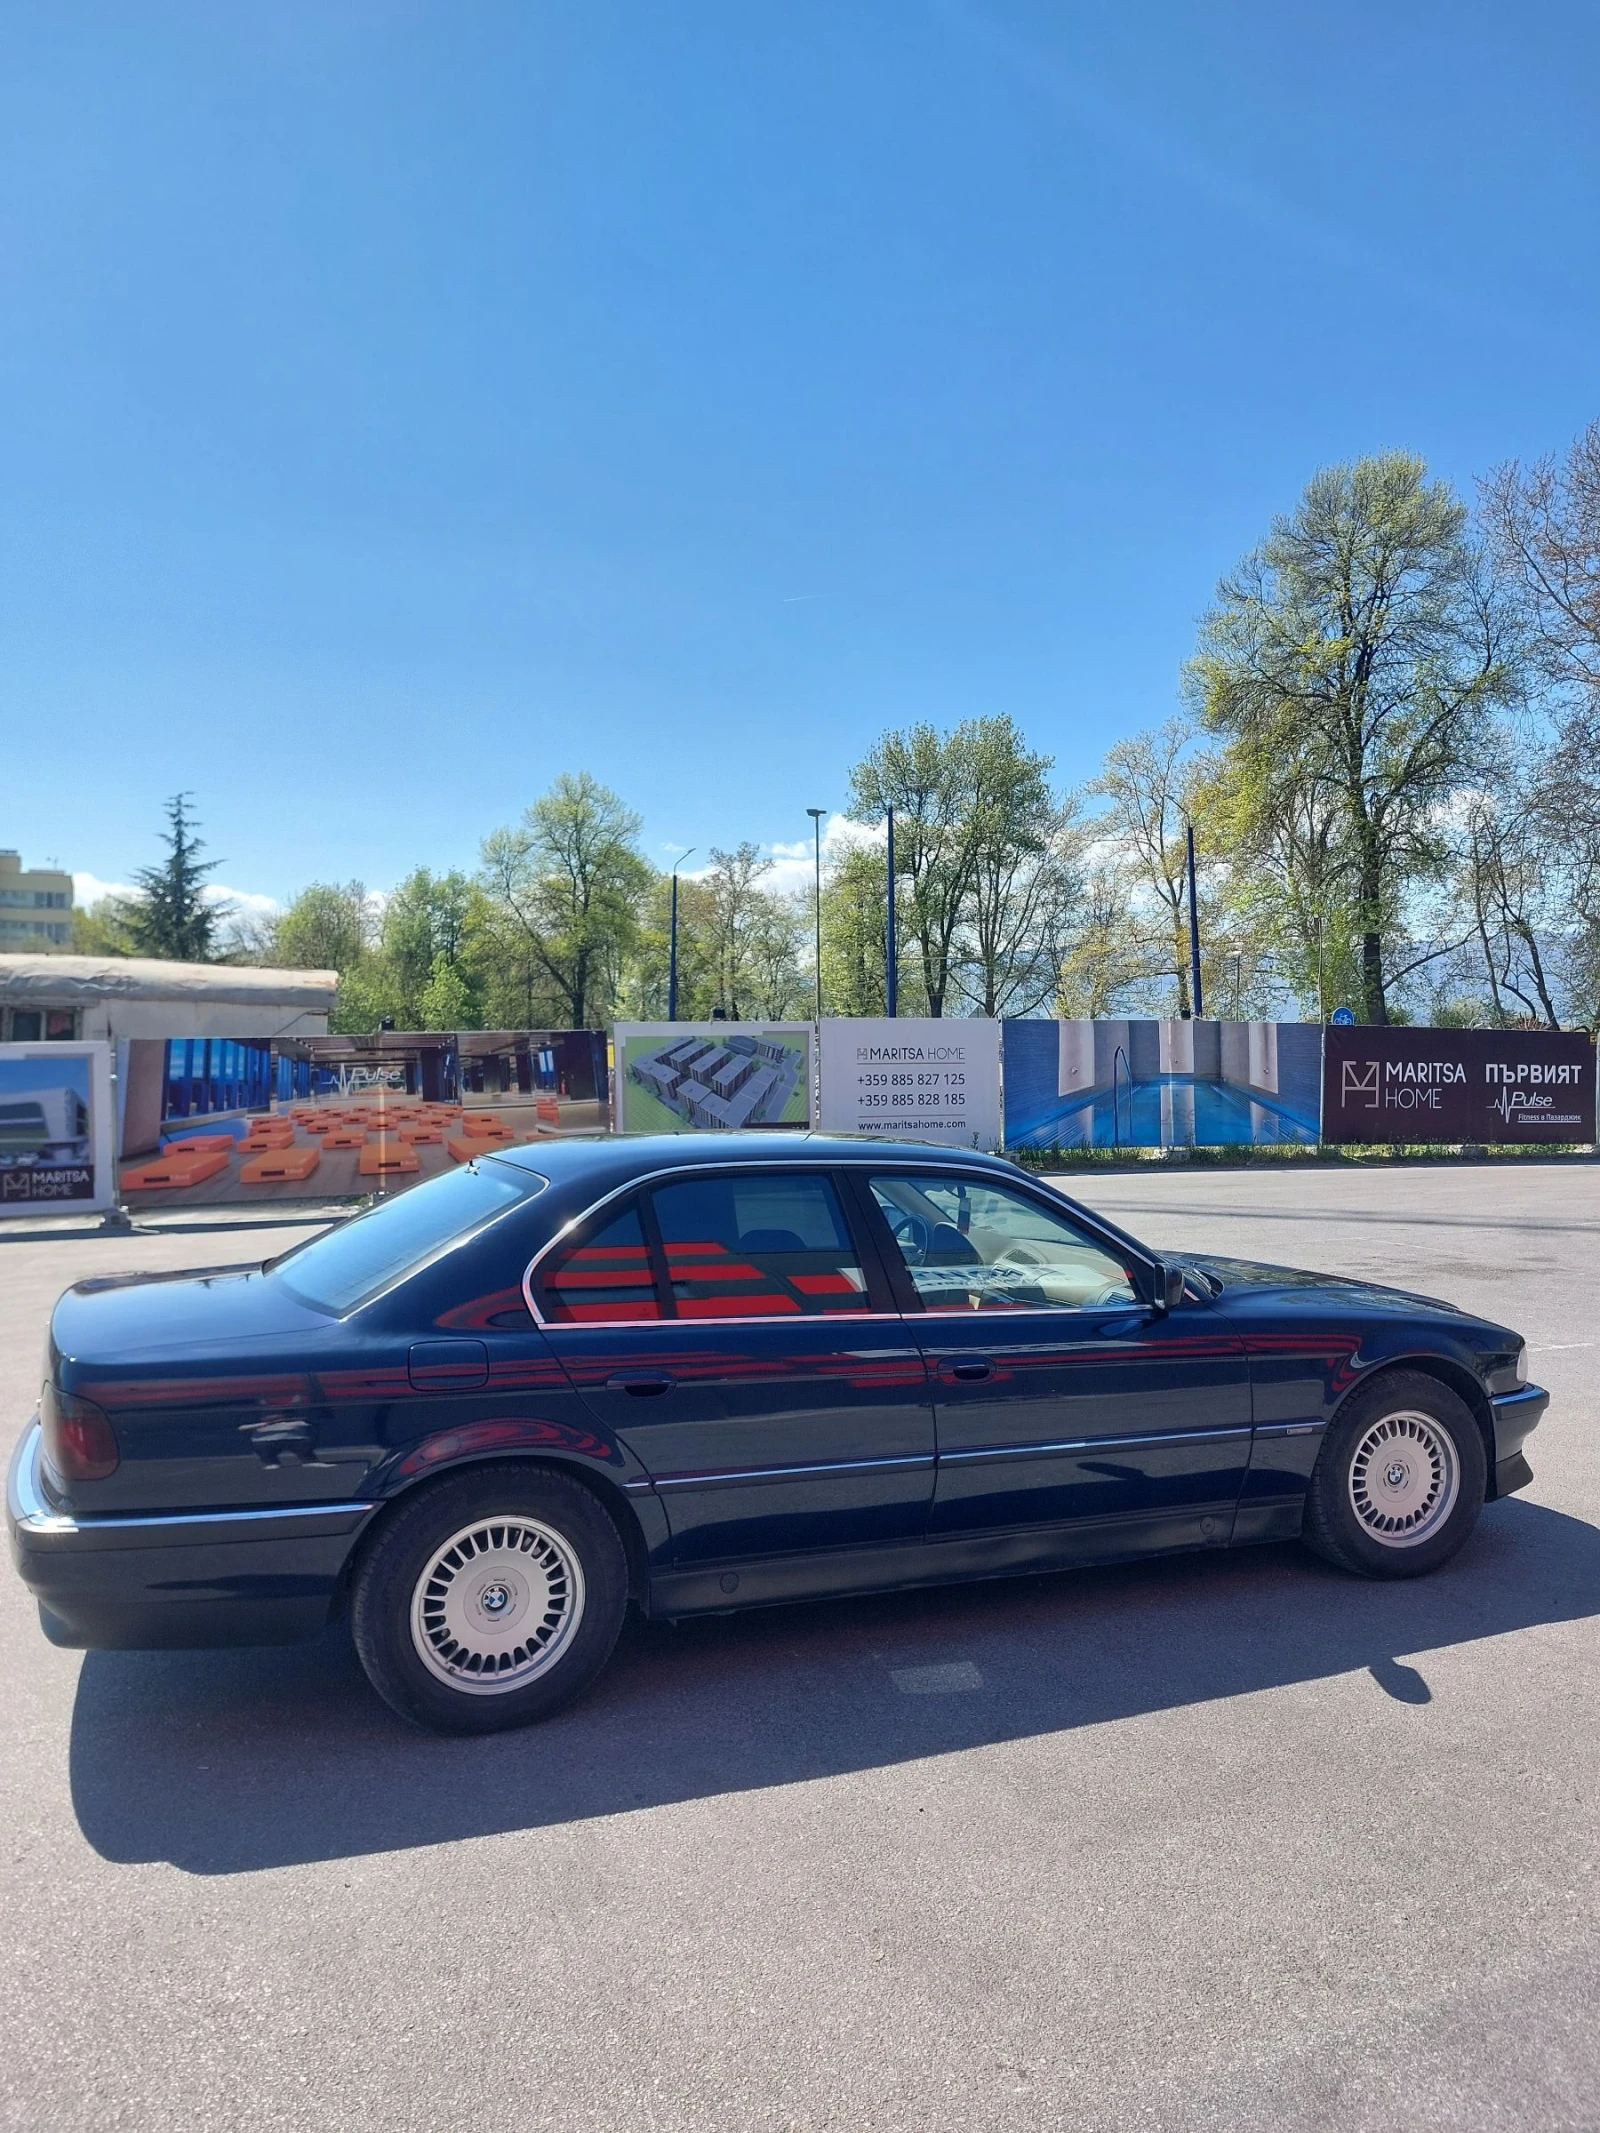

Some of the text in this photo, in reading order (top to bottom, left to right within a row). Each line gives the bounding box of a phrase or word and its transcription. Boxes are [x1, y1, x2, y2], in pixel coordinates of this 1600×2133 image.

[869, 1047, 965, 1060] MARITSA HOME
[350, 1067, 401, 1081] Pulse
[857, 1073, 965, 1086] +359 885 827 125
[1386, 1062, 1466, 1083] MARITSA
[1485, 1063, 1582, 1084] ПЪРВИЯТ
[857, 1093, 965, 1106] +359 885 828 185
[1385, 1088, 1442, 1109] HOME
[1511, 1091, 1553, 1107] Pulse
[1518, 1113, 1540, 1121] Fitness
[1546, 1113, 1581, 1122] Пазарджик
[858, 1120, 966, 1131] www.maritsahome.com
[31, 1170, 90, 1184] MARITSA
[31, 1183, 74, 1197] HOME
